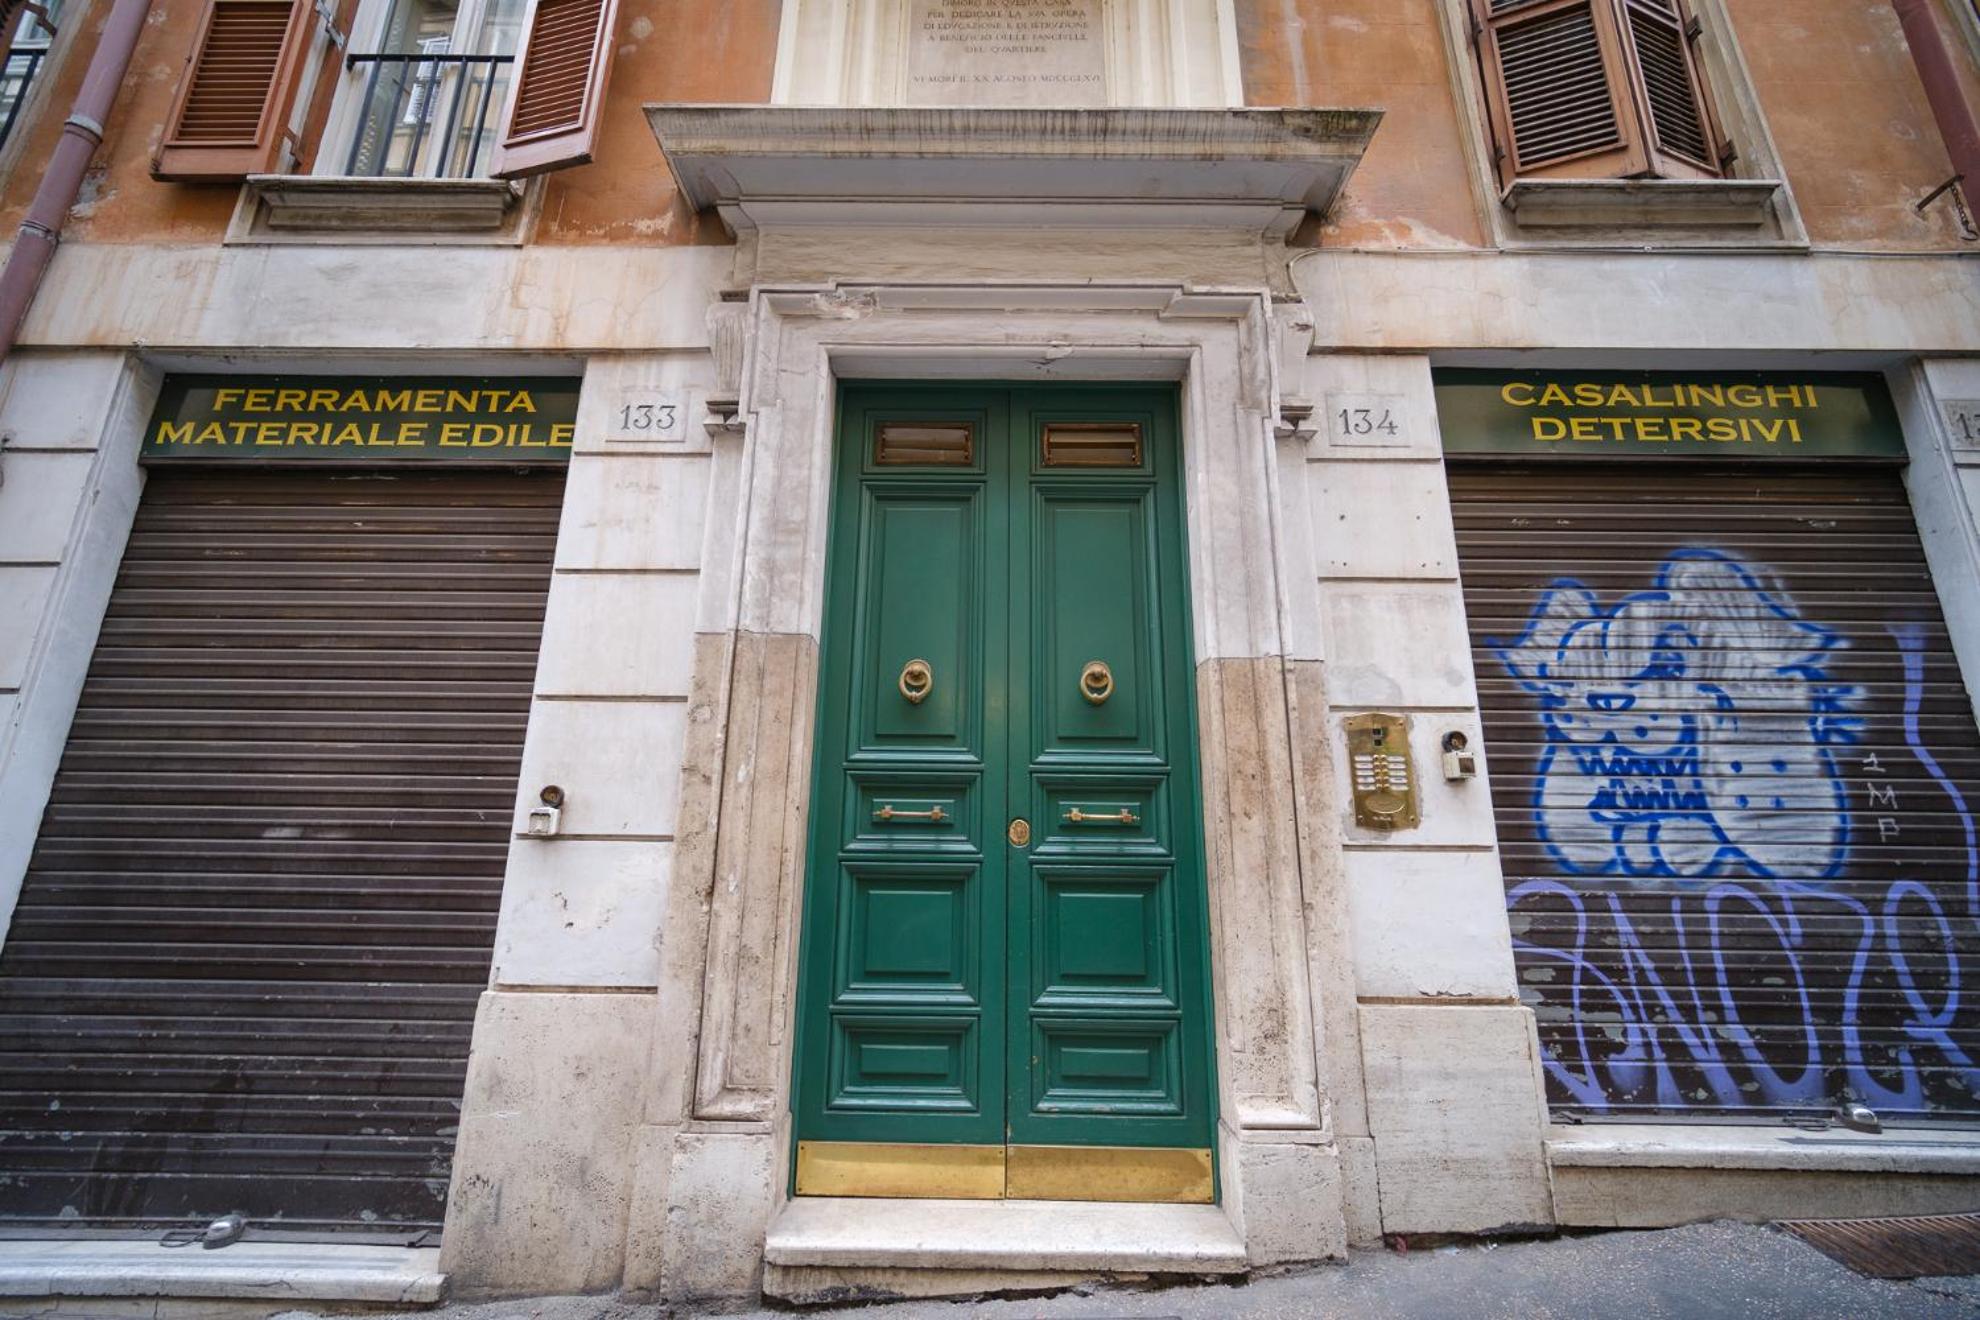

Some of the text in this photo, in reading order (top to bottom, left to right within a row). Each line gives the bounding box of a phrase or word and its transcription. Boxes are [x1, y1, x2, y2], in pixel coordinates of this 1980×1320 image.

[213, 389, 537, 413] FERRAMENTA
[1501, 382, 1818, 409] CASALINGHI
[620, 403, 676, 431] 133
[1338, 408, 1399, 436] 134
[1531, 416, 1802, 443] DETERSIVI
[155, 421, 576, 448] MATERIALE EDILE
